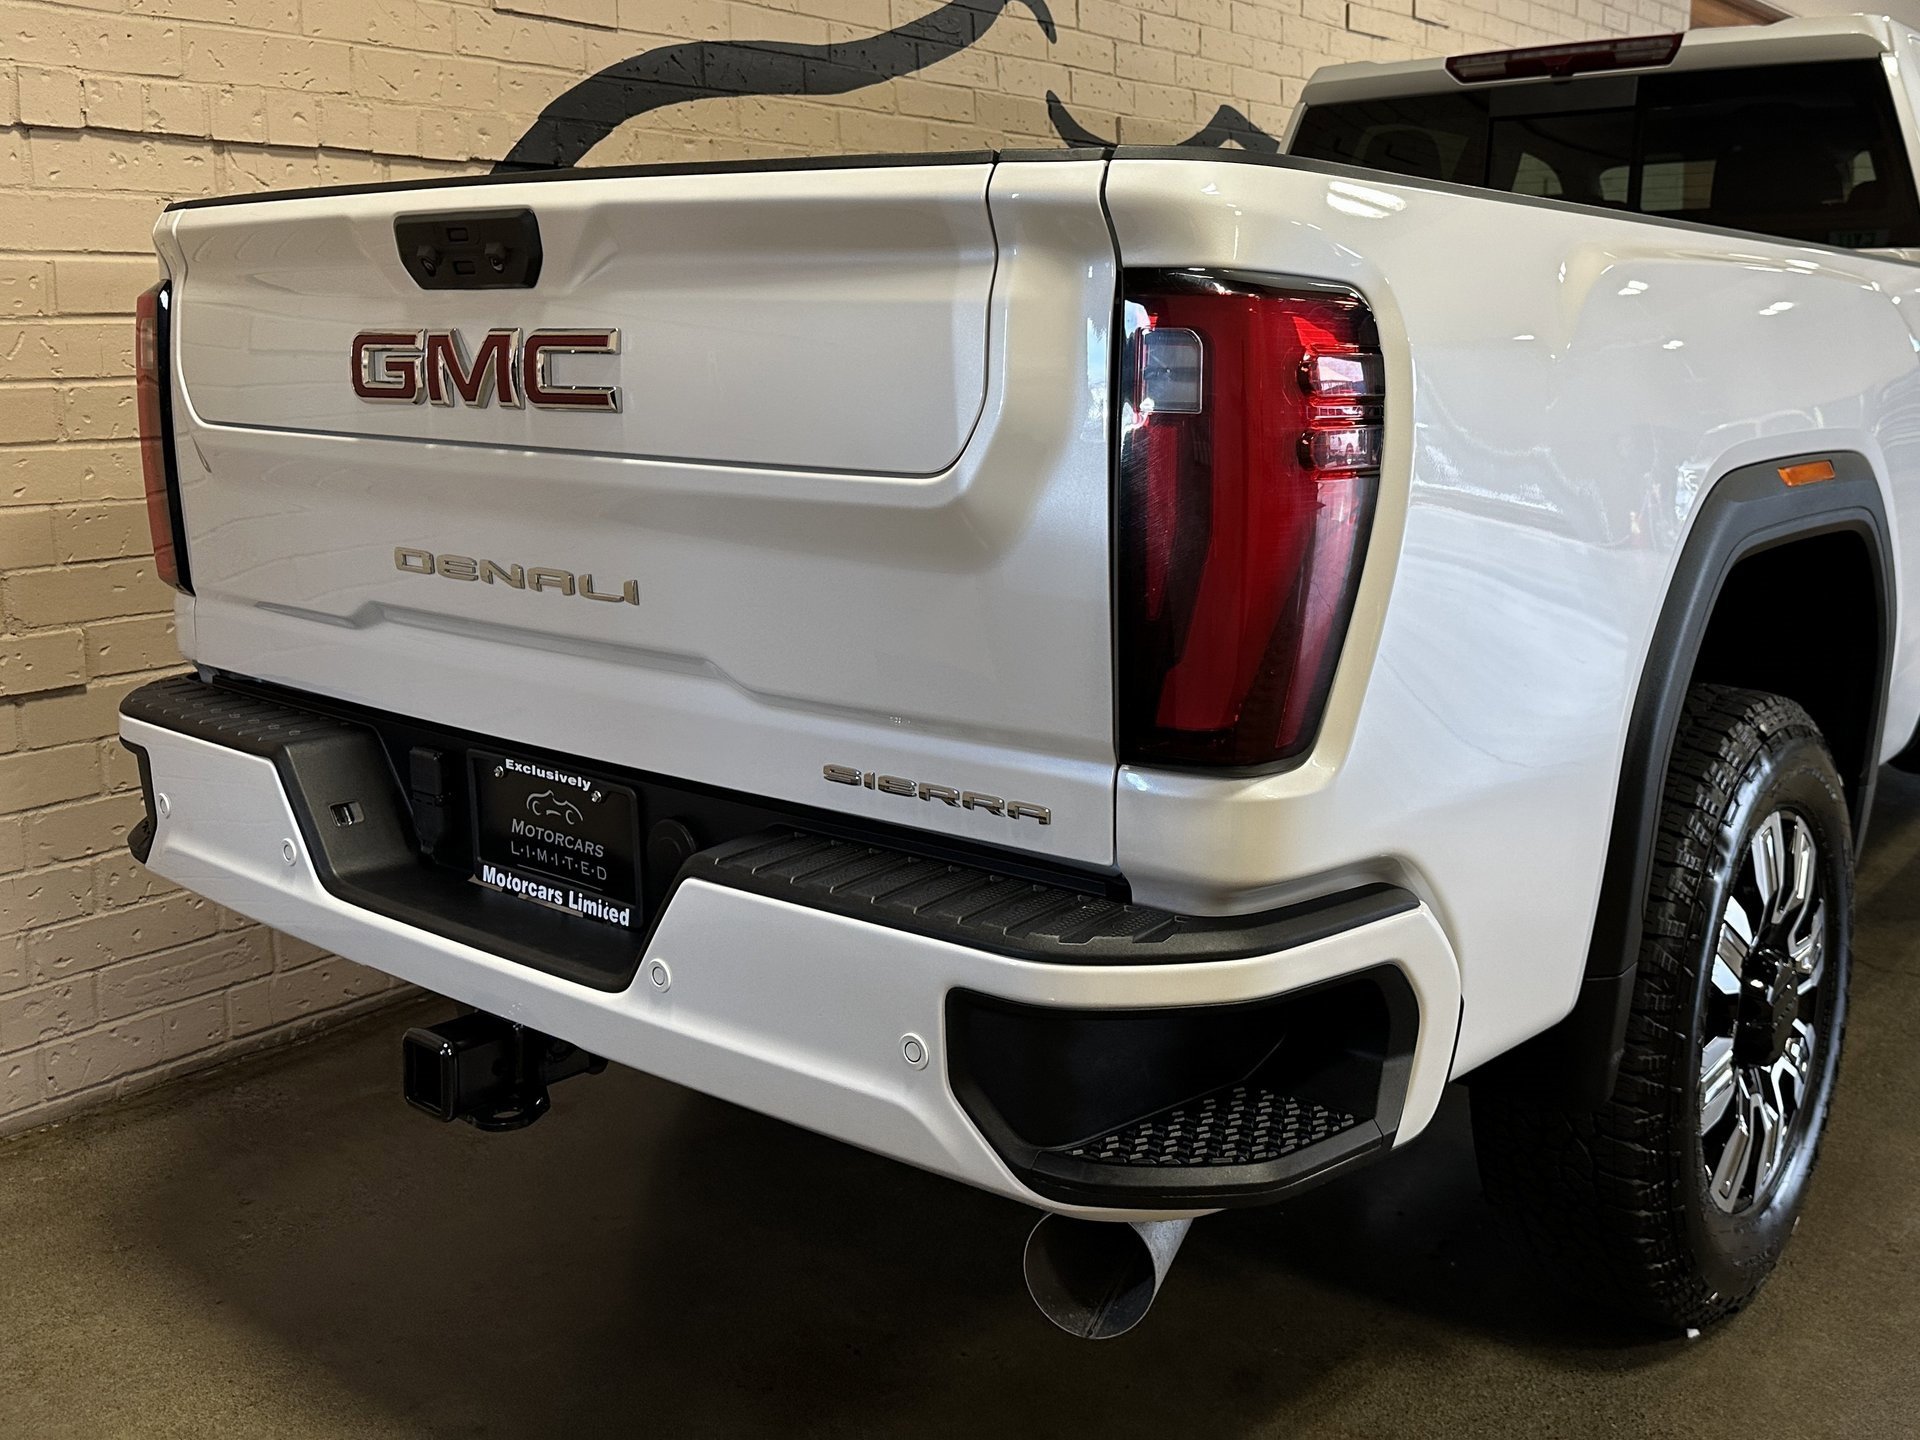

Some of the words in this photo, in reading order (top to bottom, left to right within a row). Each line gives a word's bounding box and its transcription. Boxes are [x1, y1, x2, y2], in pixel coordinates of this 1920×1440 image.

[350, 327, 623, 413] GMC
[394, 546, 640, 606] DENALI
[505, 758, 592, 792] Exclusively
[823, 763, 1051, 825] SIERRA
[511, 818, 605, 858] MOTORCARS
[482, 865, 563, 905] Motorcars
[568, 890, 630, 927] Limited
